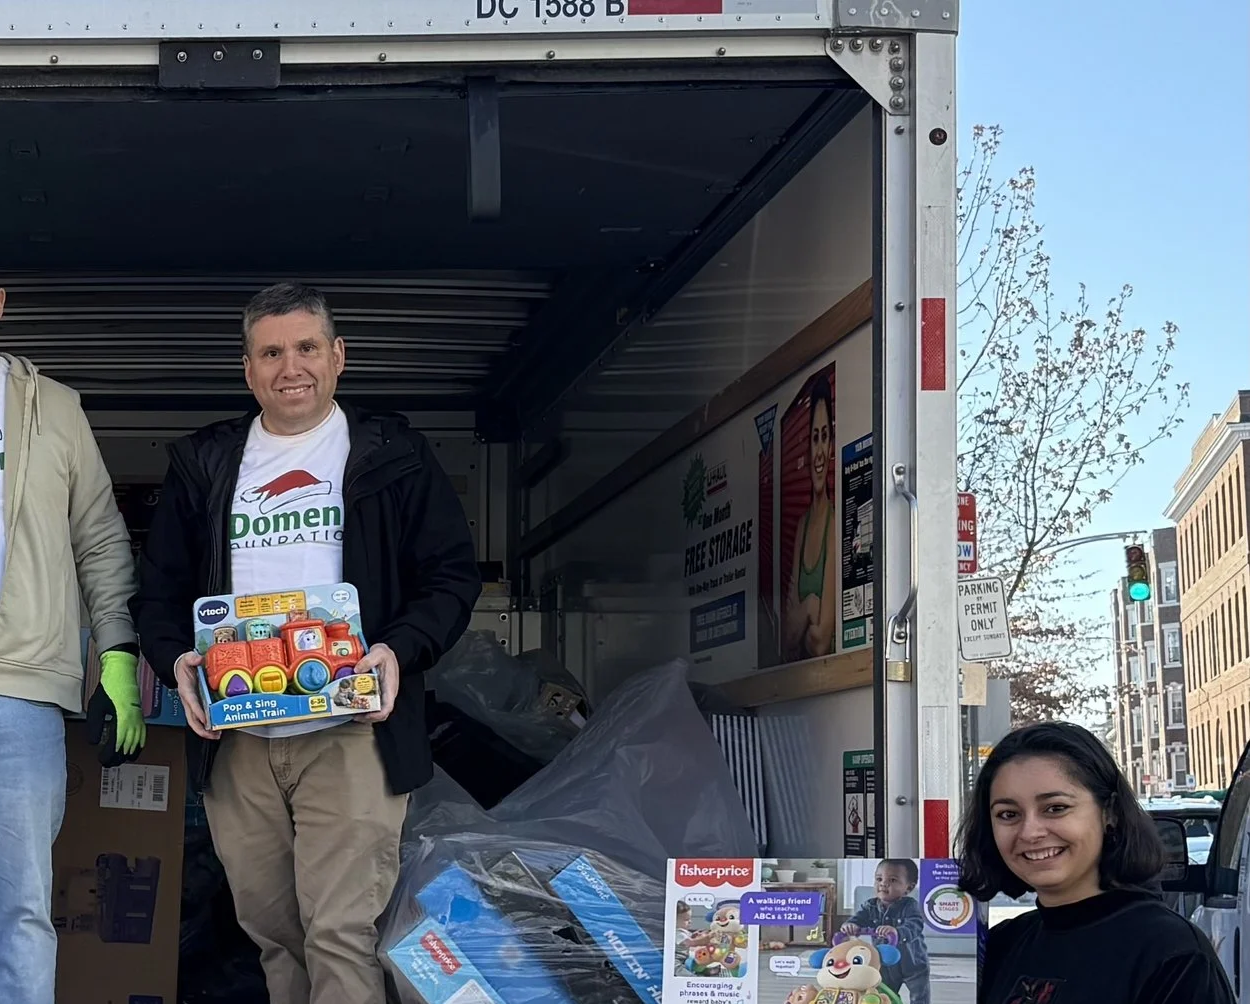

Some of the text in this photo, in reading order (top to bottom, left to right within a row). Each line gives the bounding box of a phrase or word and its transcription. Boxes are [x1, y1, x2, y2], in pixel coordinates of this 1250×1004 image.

[476, 0, 625, 19] DC 1588 B
[230, 505, 341, 540] Domen
[230, 530, 344, 549] OUNDATIO
[684, 518, 753, 578] FREE STORAGE
[958, 582, 999, 597] PARKING
[199, 606, 228, 617] vtech
[964, 601, 997, 616] PERMIT
[971, 618, 994, 632] ONLY
[223, 699, 277, 714] Pop & Sing
[224, 710, 259, 722] Animal
[679, 864, 749, 879] fisher-price
[756, 898, 786, 906] walking
[687, 981, 734, 990] Encouraging
